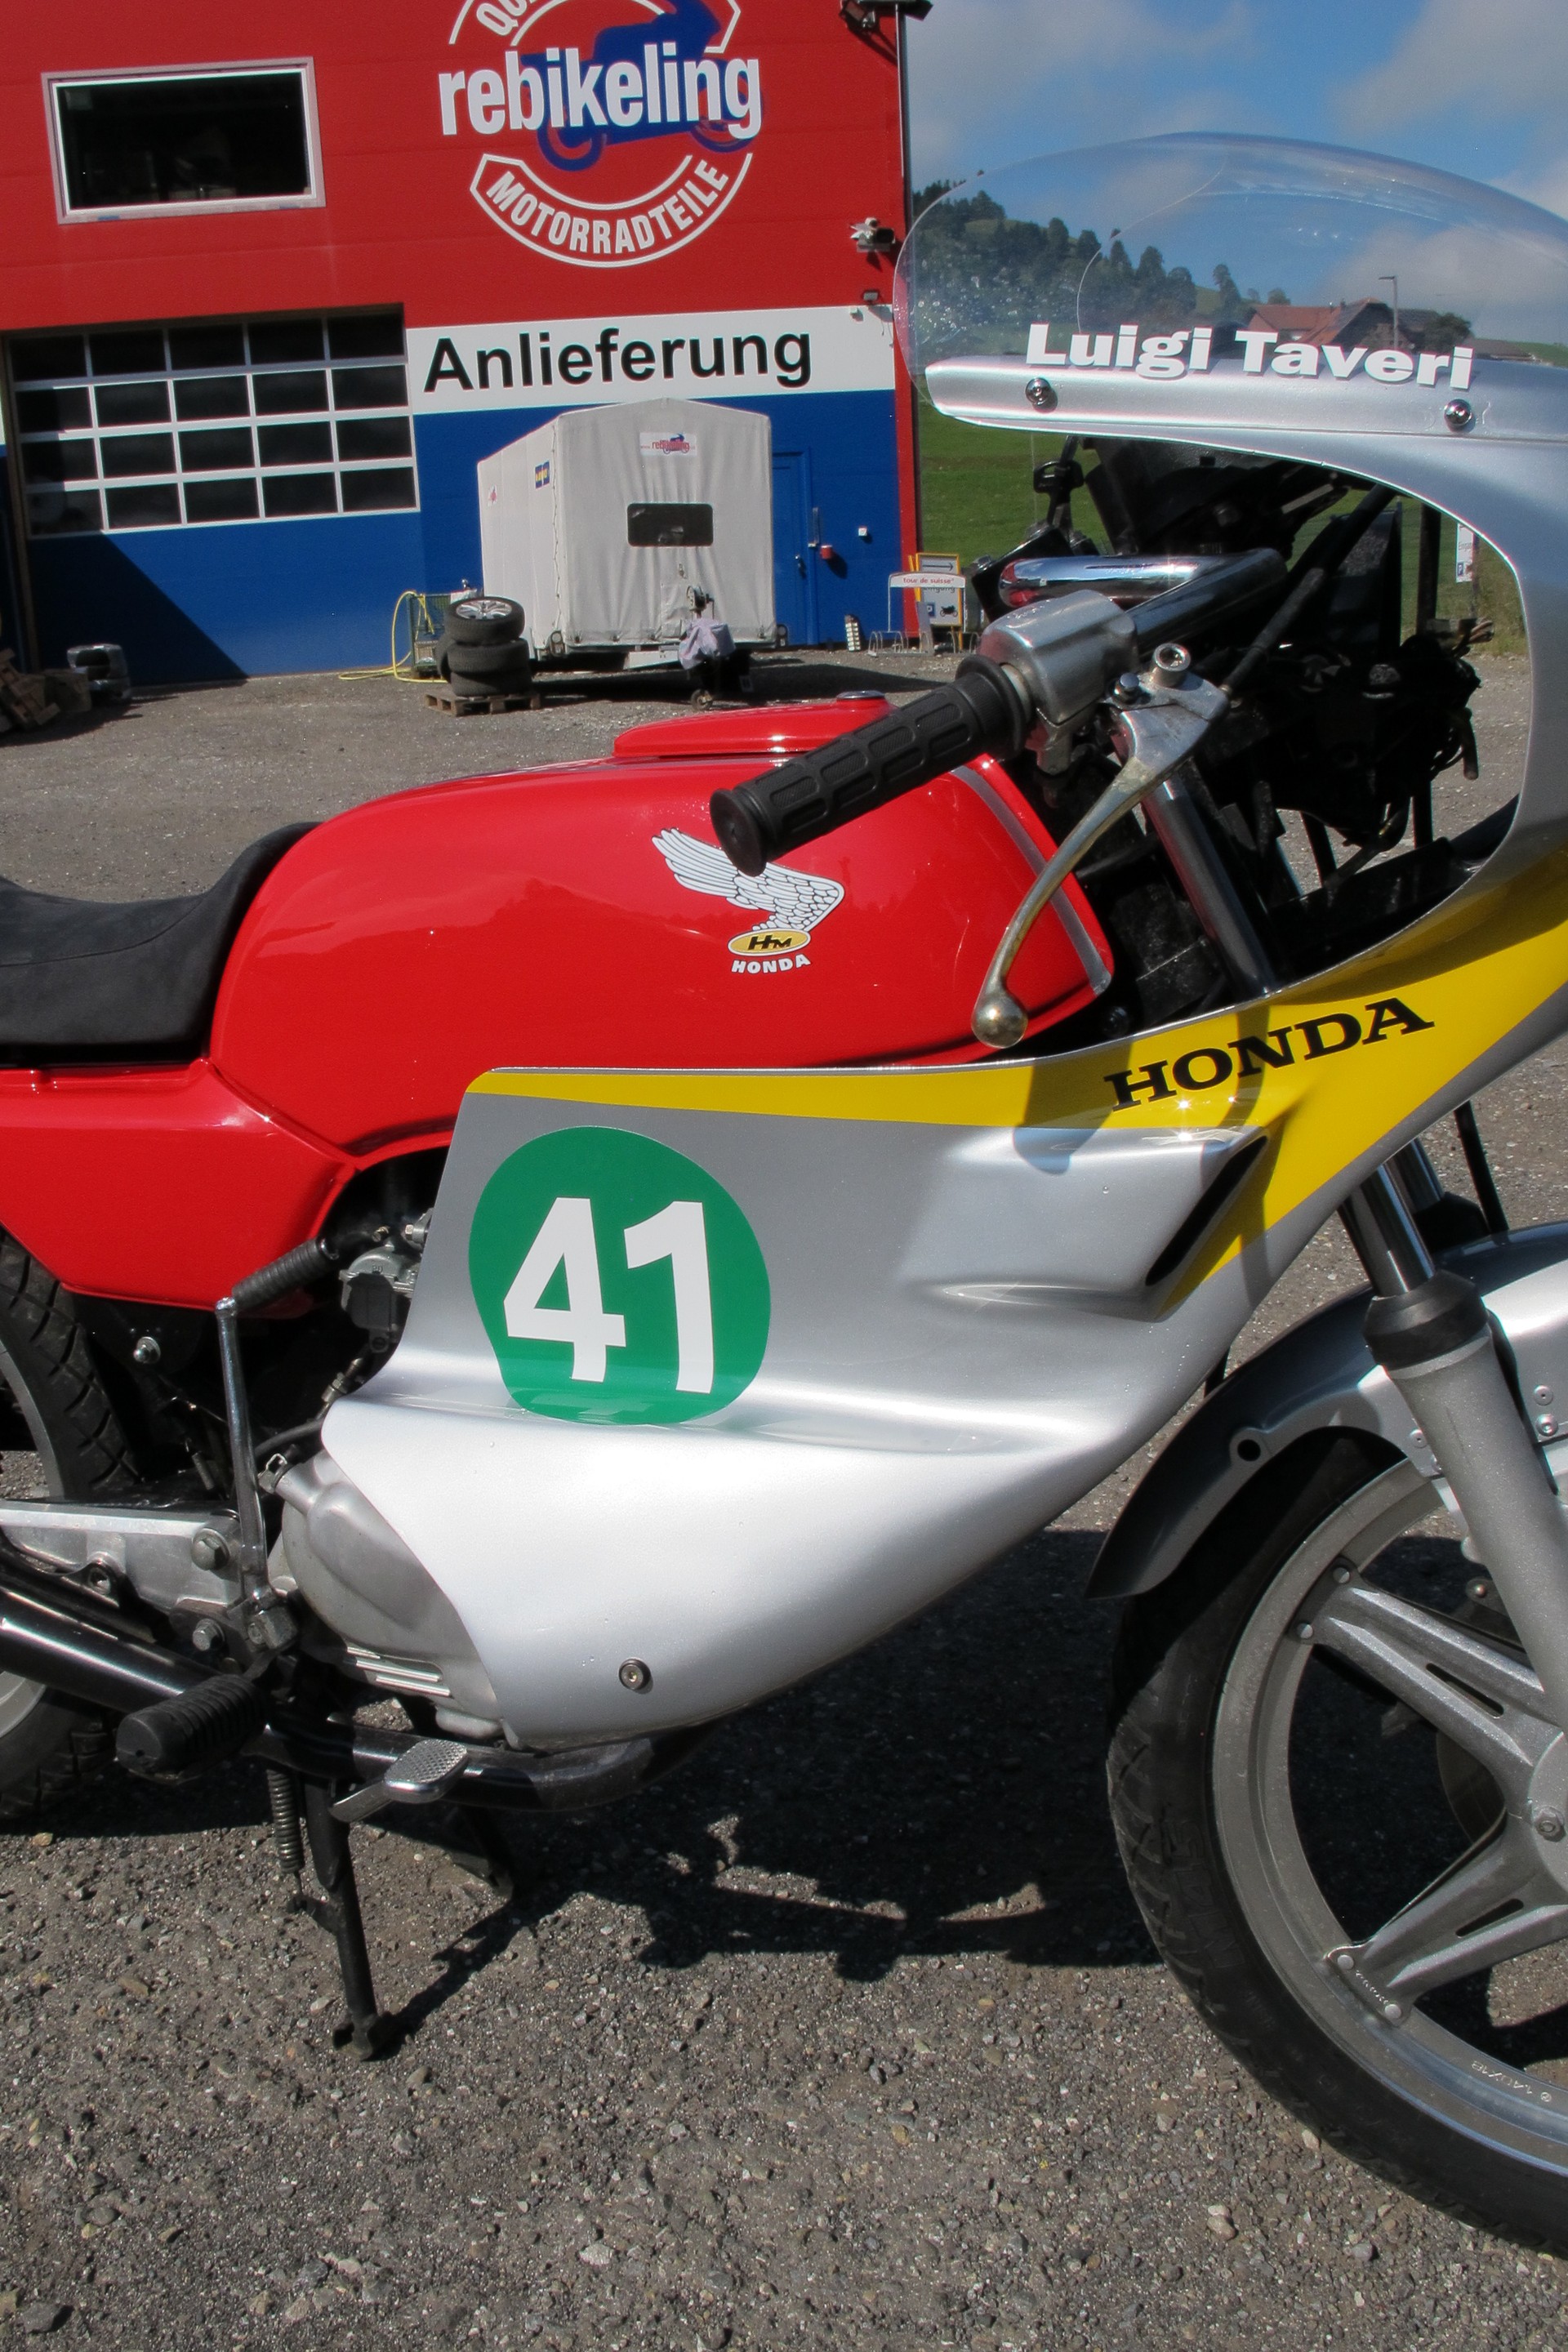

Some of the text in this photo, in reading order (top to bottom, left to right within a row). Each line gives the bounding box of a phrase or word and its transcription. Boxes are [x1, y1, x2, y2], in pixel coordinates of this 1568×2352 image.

[476, 0, 536, 36] QU
[439, 42, 762, 140] rebikeling
[486, 159, 729, 254] MOTORRADTEILE
[423, 327, 812, 393] Anlieferung
[1026, 323, 1474, 390] Luigi Taveri
[731, 953, 811, 973] HONDA
[1103, 997, 1435, 1112] HONDA
[503, 1197, 715, 1394] 41
